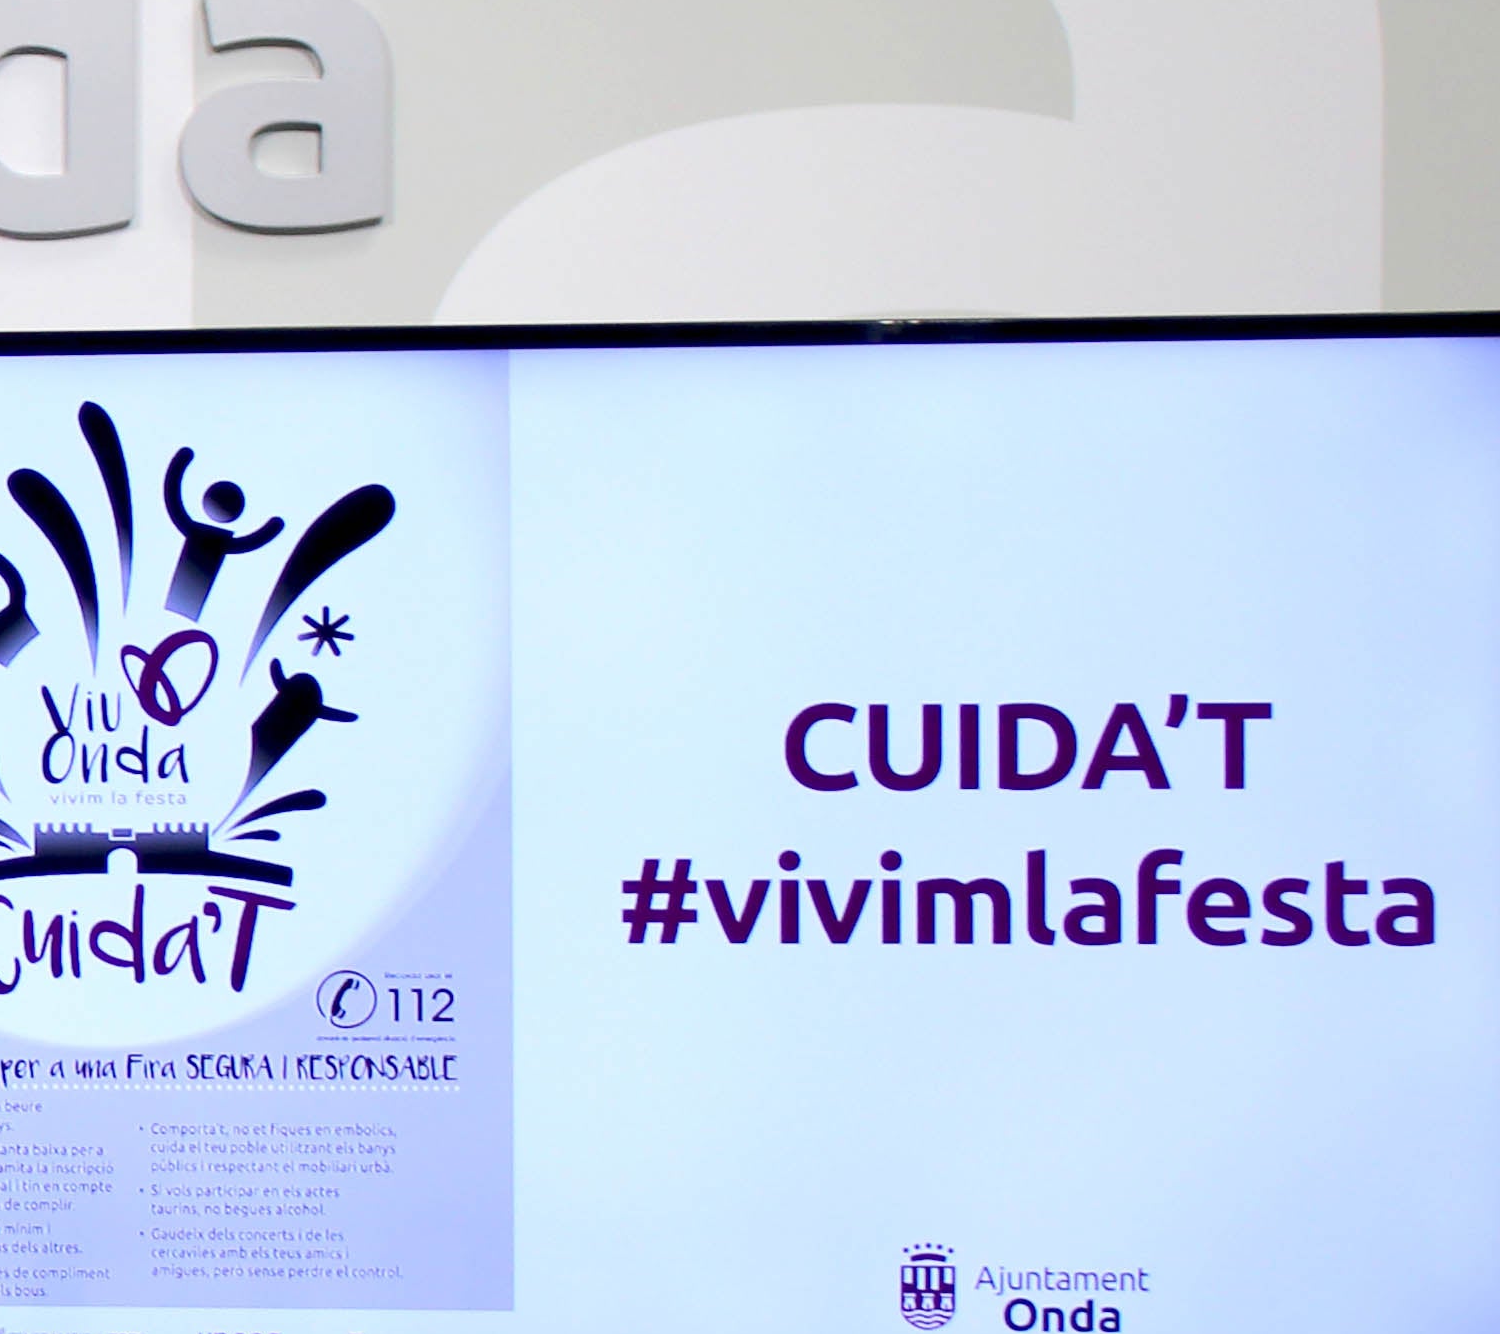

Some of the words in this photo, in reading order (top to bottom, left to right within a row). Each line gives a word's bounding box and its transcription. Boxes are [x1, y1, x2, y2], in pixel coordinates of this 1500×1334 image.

[40, 683, 121, 738] Viu
[40, 725, 190, 785] Onda
[785, 694, 1271, 792] CUIDA'T
[49, 791, 104, 807] vivim
[111, 789, 128, 807] la
[135, 789, 188, 807] festa
[621, 848, 1436, 949] #vivimlafesta
[389, 989, 454, 1022] 112
[0, 1058, 39, 1087] per
[50, 1059, 64, 1078] a
[75, 1059, 116, 1079] una
[127, 1054, 176, 1079] Fira
[186, 1054, 272, 1080] SEGURA
[282, 1055, 288, 1079] I
[297, 1054, 457, 1081] RESPONSABLE
[974, 1264, 1150, 1298] Ajuntament
[1002, 1298, 1123, 1334] Onda
